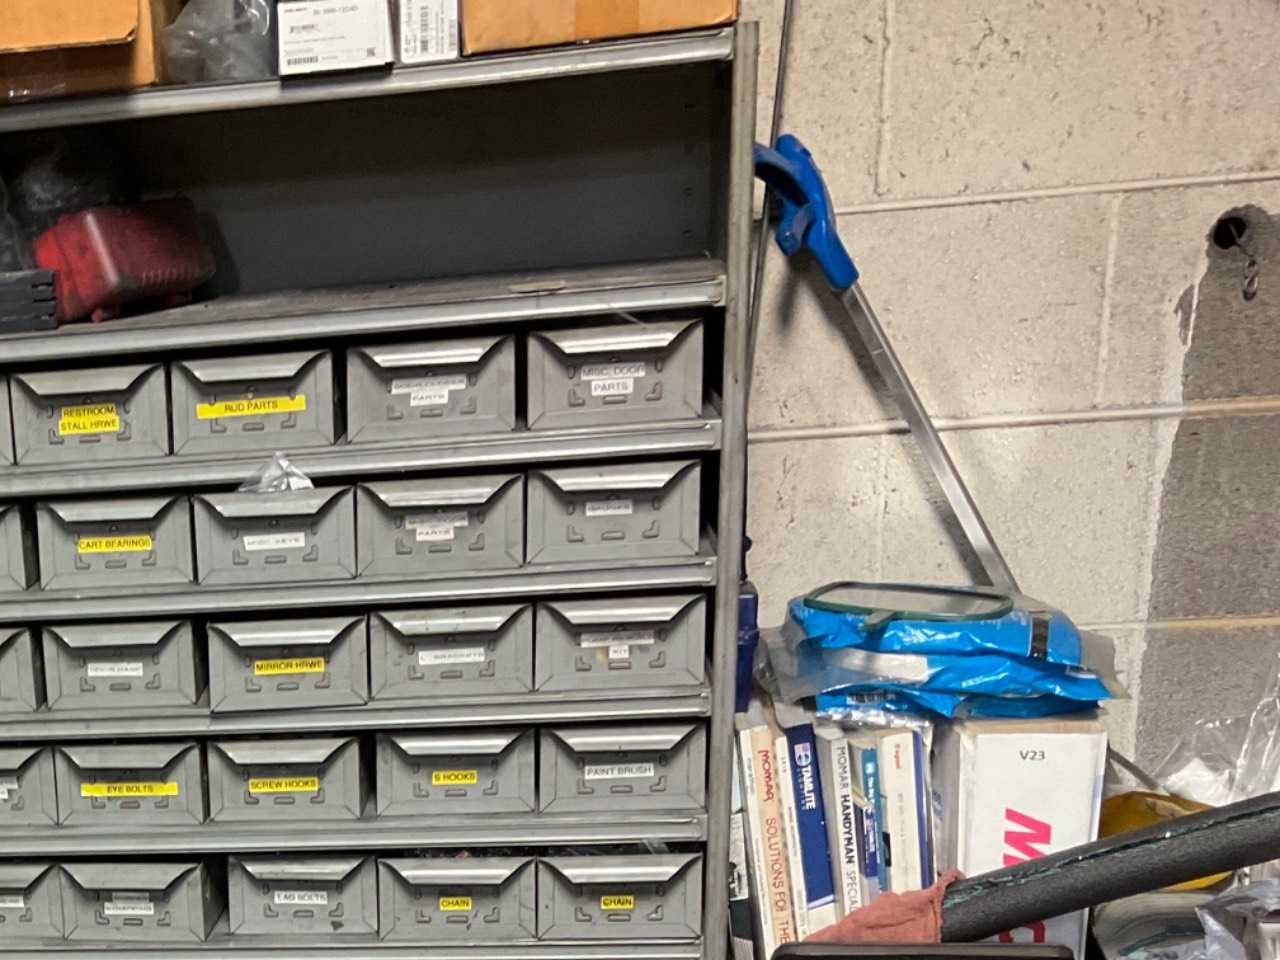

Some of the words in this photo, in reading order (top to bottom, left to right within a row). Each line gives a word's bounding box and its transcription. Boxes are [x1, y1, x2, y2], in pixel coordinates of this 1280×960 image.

[593, 381, 629, 393] PARTS
[247, 400, 278, 411] PARTS
[63, 405, 116, 418] RESTROOM
[60, 420, 88, 431] STALL
[79, 539, 103, 550] CART
[1019, 750, 1045, 761] V23
[586, 766, 617, 777] PAINT
[618, 764, 653, 775] BRUSH
[836, 746, 849, 790] MOMAR
[442, 772, 476, 782] HOOKS
[130, 783, 154, 792] BOLTS
[251, 779, 283, 789] SCREW
[285, 778, 316, 788] HOOKS
[840, 794, 855, 864] HANDYMAN
[766, 818, 784, 894] SOLUTIONS
[441, 898, 470, 908] CHAIN
[602, 897, 632, 907] CHAIN
